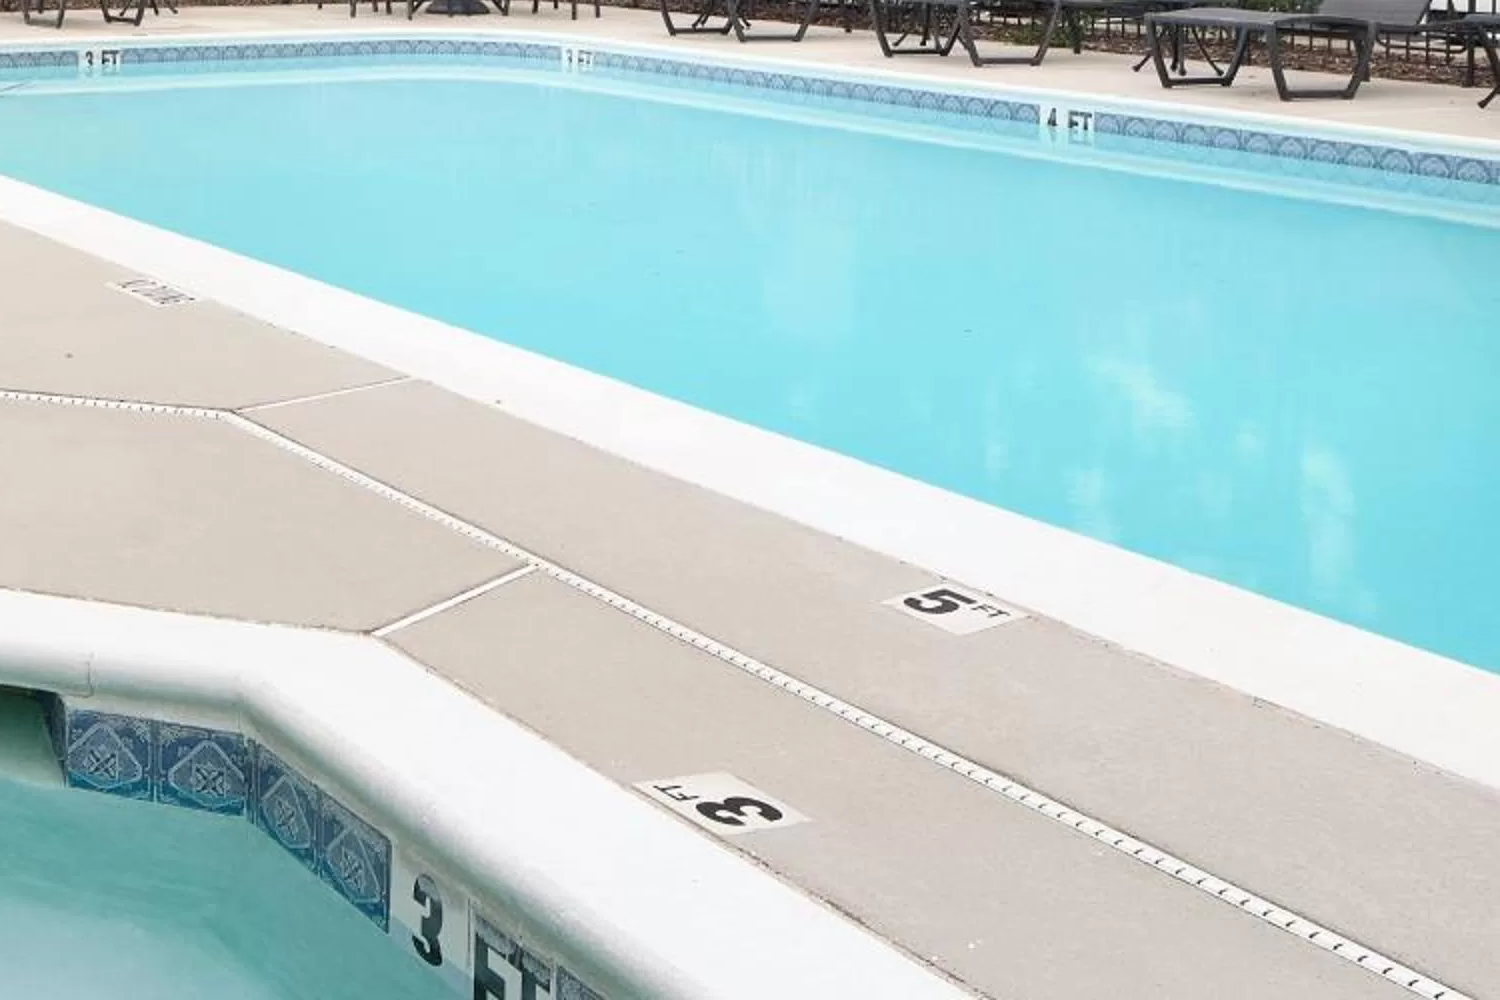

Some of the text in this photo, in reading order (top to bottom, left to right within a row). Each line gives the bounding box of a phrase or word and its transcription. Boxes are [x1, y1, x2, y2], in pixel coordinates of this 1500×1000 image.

[85, 50, 120, 66] 3 FT
[1047, 107, 1092, 130] 4 FT
[903, 588, 1011, 618] 5 FT
[652, 784, 783, 826] 3 FT
[412, 873, 443, 966] 3
